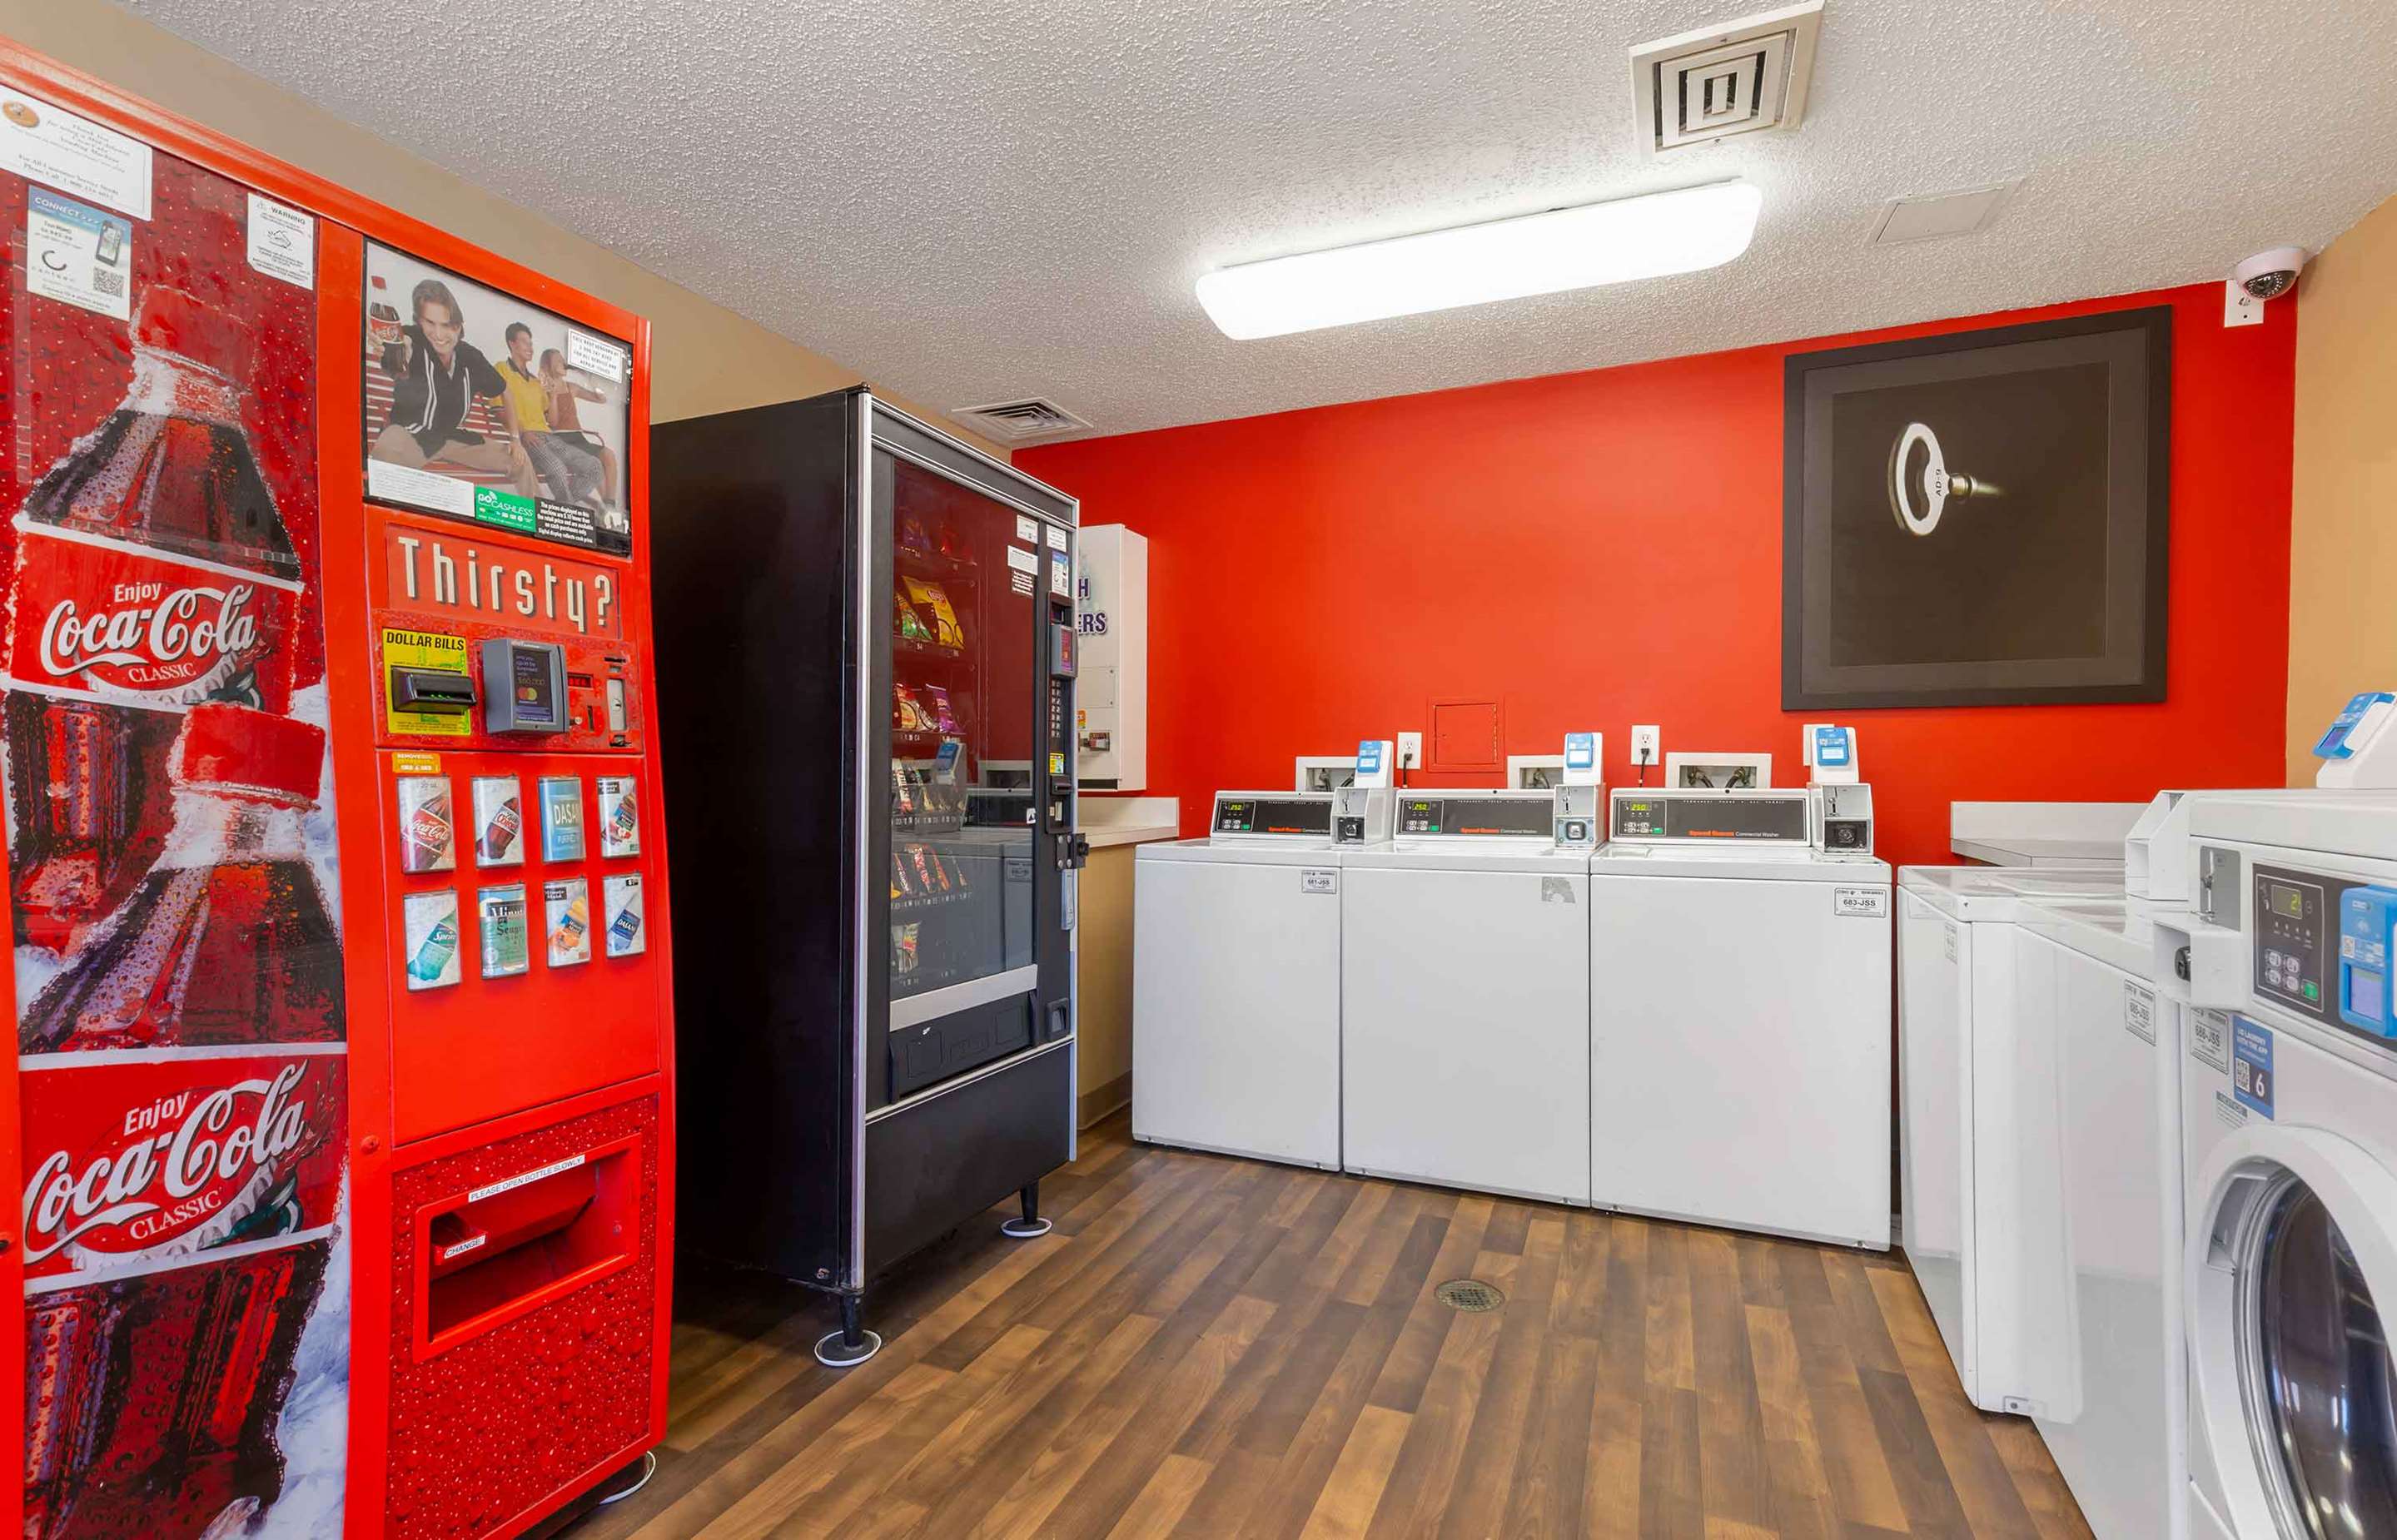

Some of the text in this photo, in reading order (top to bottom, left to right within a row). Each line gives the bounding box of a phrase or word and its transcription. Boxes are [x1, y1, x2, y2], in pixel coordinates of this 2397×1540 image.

[34, 196, 81, 217] CONNECT
[271, 206, 306, 225] WARNING
[491, 500, 534, 517] CASHLESS
[114, 583, 162, 604] Enjoy
[398, 536, 612, 633] Thirsty?
[40, 584, 256, 677] Coca-Cola
[386, 632, 465, 651] DOLLAR BILLS
[127, 662, 198, 683] CLASSIC
[2256, 1073, 2265, 1097] 6
[123, 1091, 189, 1137] Enjoy
[23, 1059, 309, 1264] Coca-Cola
[470, 1157, 583, 1201] PLEASE OPEN BOTTLE SLOWLY
[129, 1190, 222, 1240] CLASSIC
[445, 1239, 480, 1258] CHANGE
